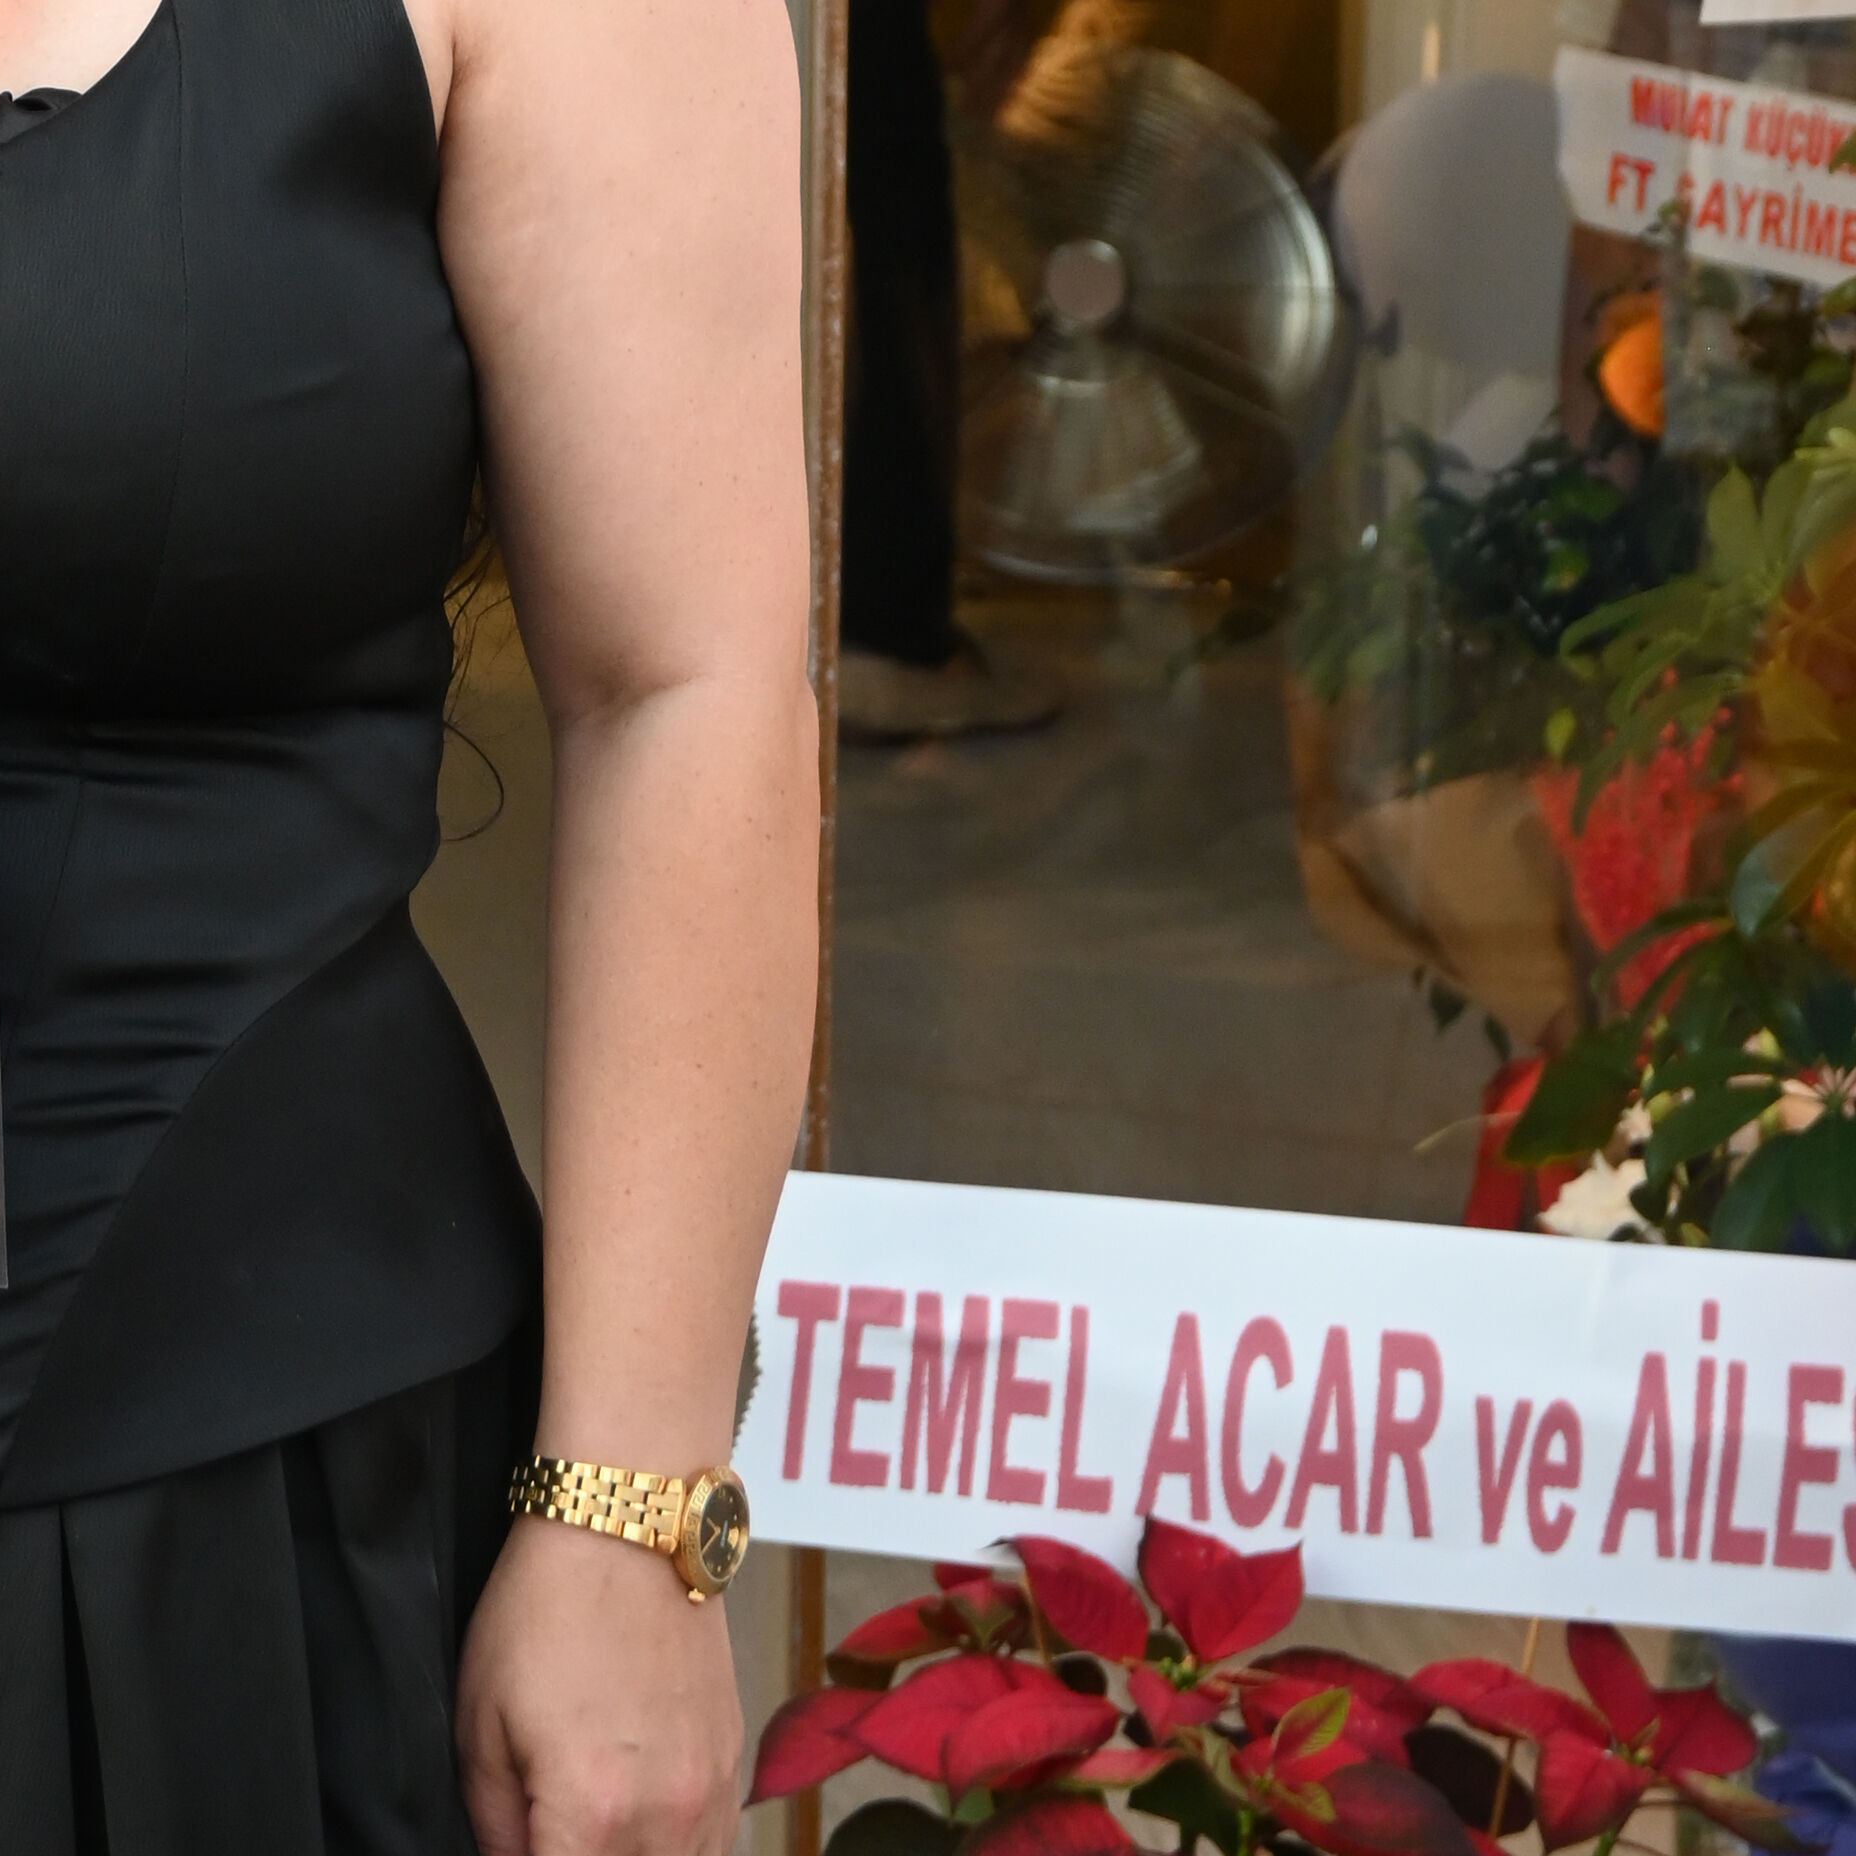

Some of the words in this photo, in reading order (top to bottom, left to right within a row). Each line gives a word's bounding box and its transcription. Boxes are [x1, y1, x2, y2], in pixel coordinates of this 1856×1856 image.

[1605, 151, 1656, 212] FT
[777, 1279, 1113, 1514] TEMEL
[1136, 1312, 1444, 1538] ACAR
[1476, 1396, 1583, 1554] ve
[1601, 1298, 1856, 1572] AİLE
